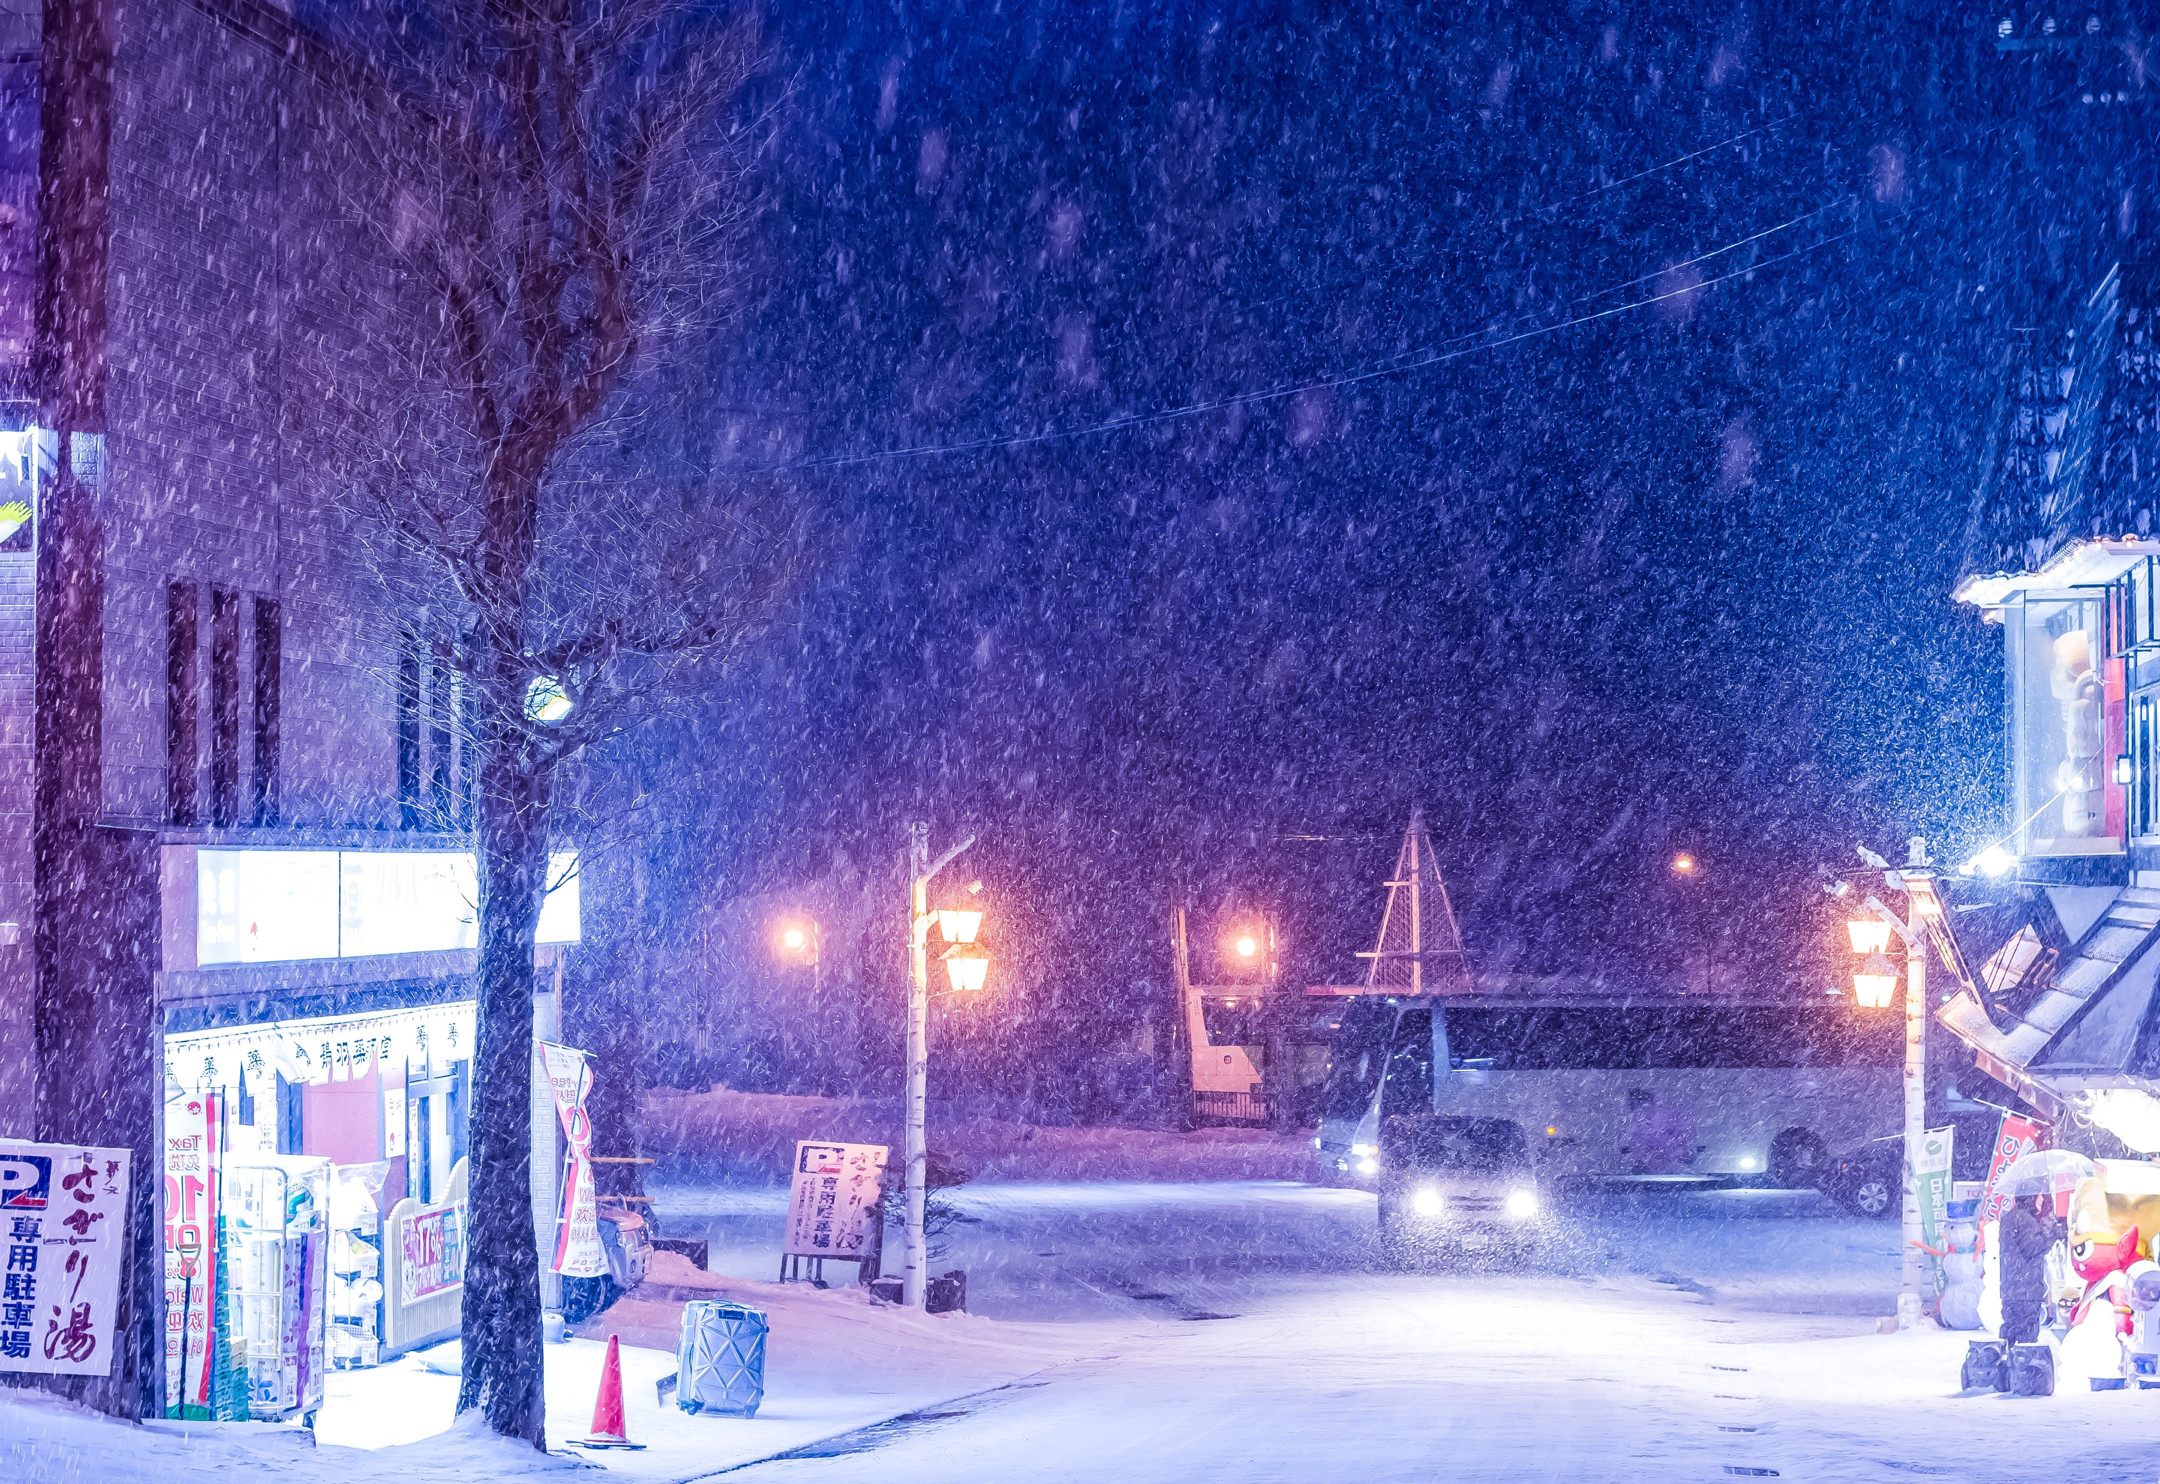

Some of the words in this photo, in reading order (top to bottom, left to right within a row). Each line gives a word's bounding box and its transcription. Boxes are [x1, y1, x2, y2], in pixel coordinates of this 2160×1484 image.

[0, 1215, 43, 1358] 専用駐車場
[44, 1164, 104, 1362] さぎり湯
